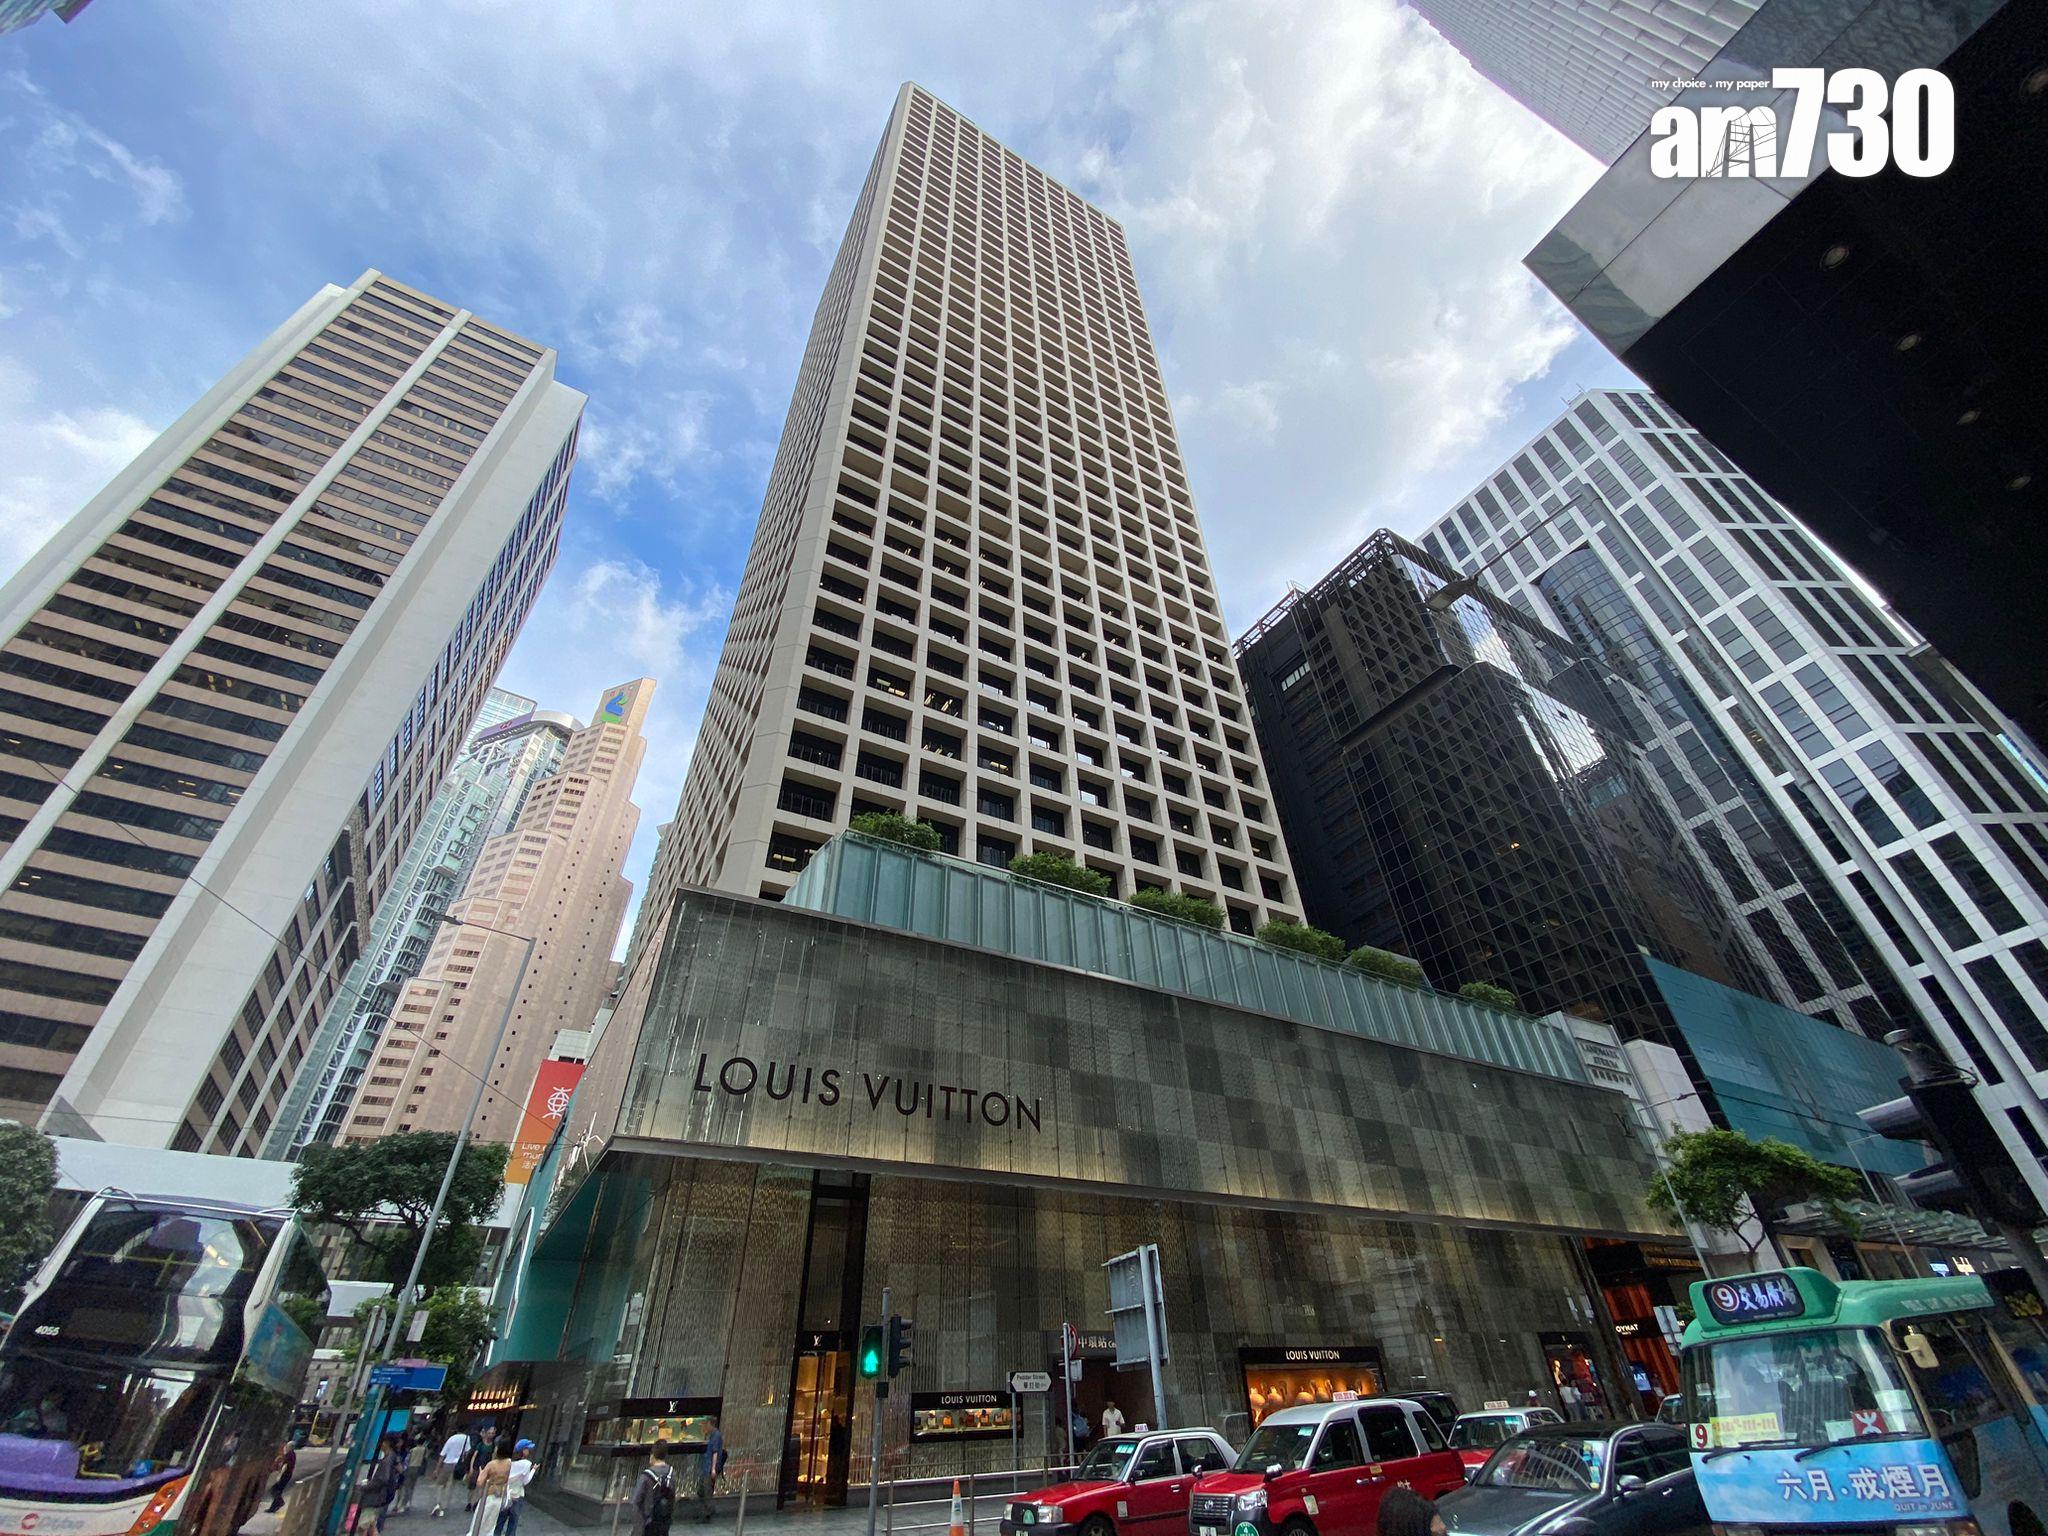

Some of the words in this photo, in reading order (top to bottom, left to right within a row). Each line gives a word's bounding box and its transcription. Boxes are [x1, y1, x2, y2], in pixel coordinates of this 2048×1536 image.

[694, 1053, 841, 1107] LOUIS
[863, 1073, 1041, 1134] VUITTON
[522, 1142, 541, 1151] Live
[1717, 1287, 1733, 1307] 9
[1285, 1350, 1308, 1360] LOUIS
[1308, 1350, 1340, 1360] VUITTON
[941, 1396, 963, 1405] LOUIS
[965, 1395, 997, 1403] VUITTON
[1695, 1425, 1708, 1449] 9
[1894, 1503, 1915, 1512] QUIT
[1930, 1502, 1955, 1512] JUNE
